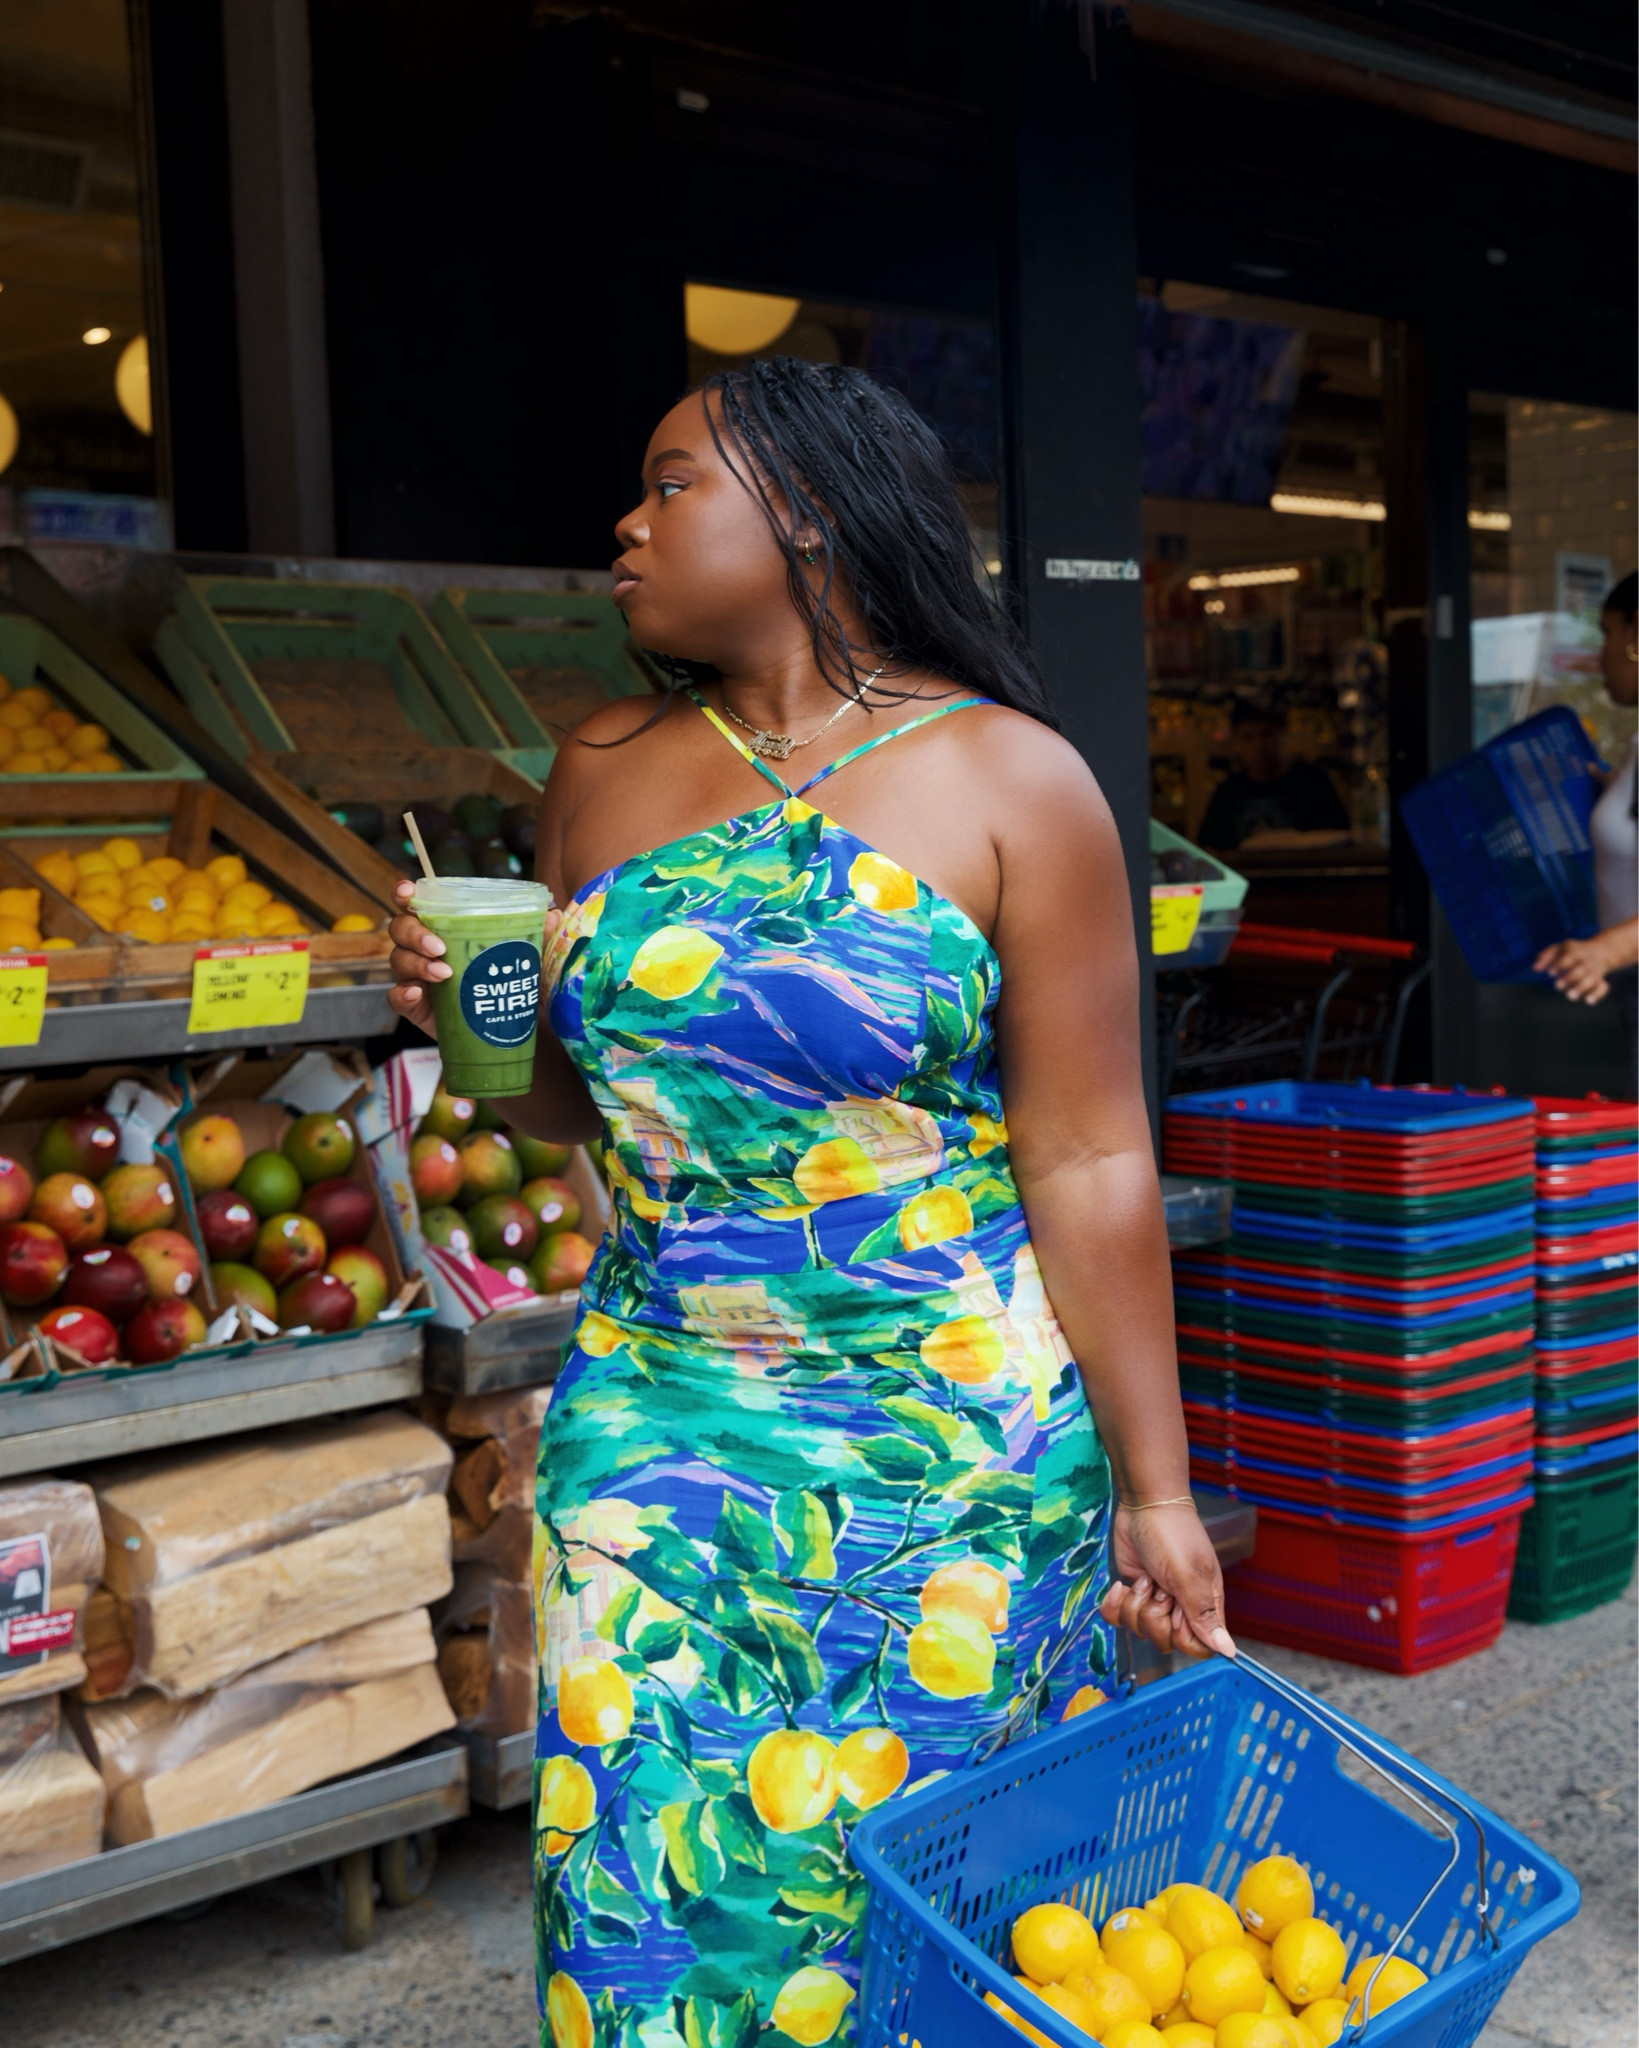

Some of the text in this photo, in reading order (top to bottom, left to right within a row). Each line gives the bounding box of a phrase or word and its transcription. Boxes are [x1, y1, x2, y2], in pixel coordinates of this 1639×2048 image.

[473, 973, 539, 997] SWEET
[474, 988, 538, 1015] FIRE
[514, 1008, 535, 1020] STUDIO
